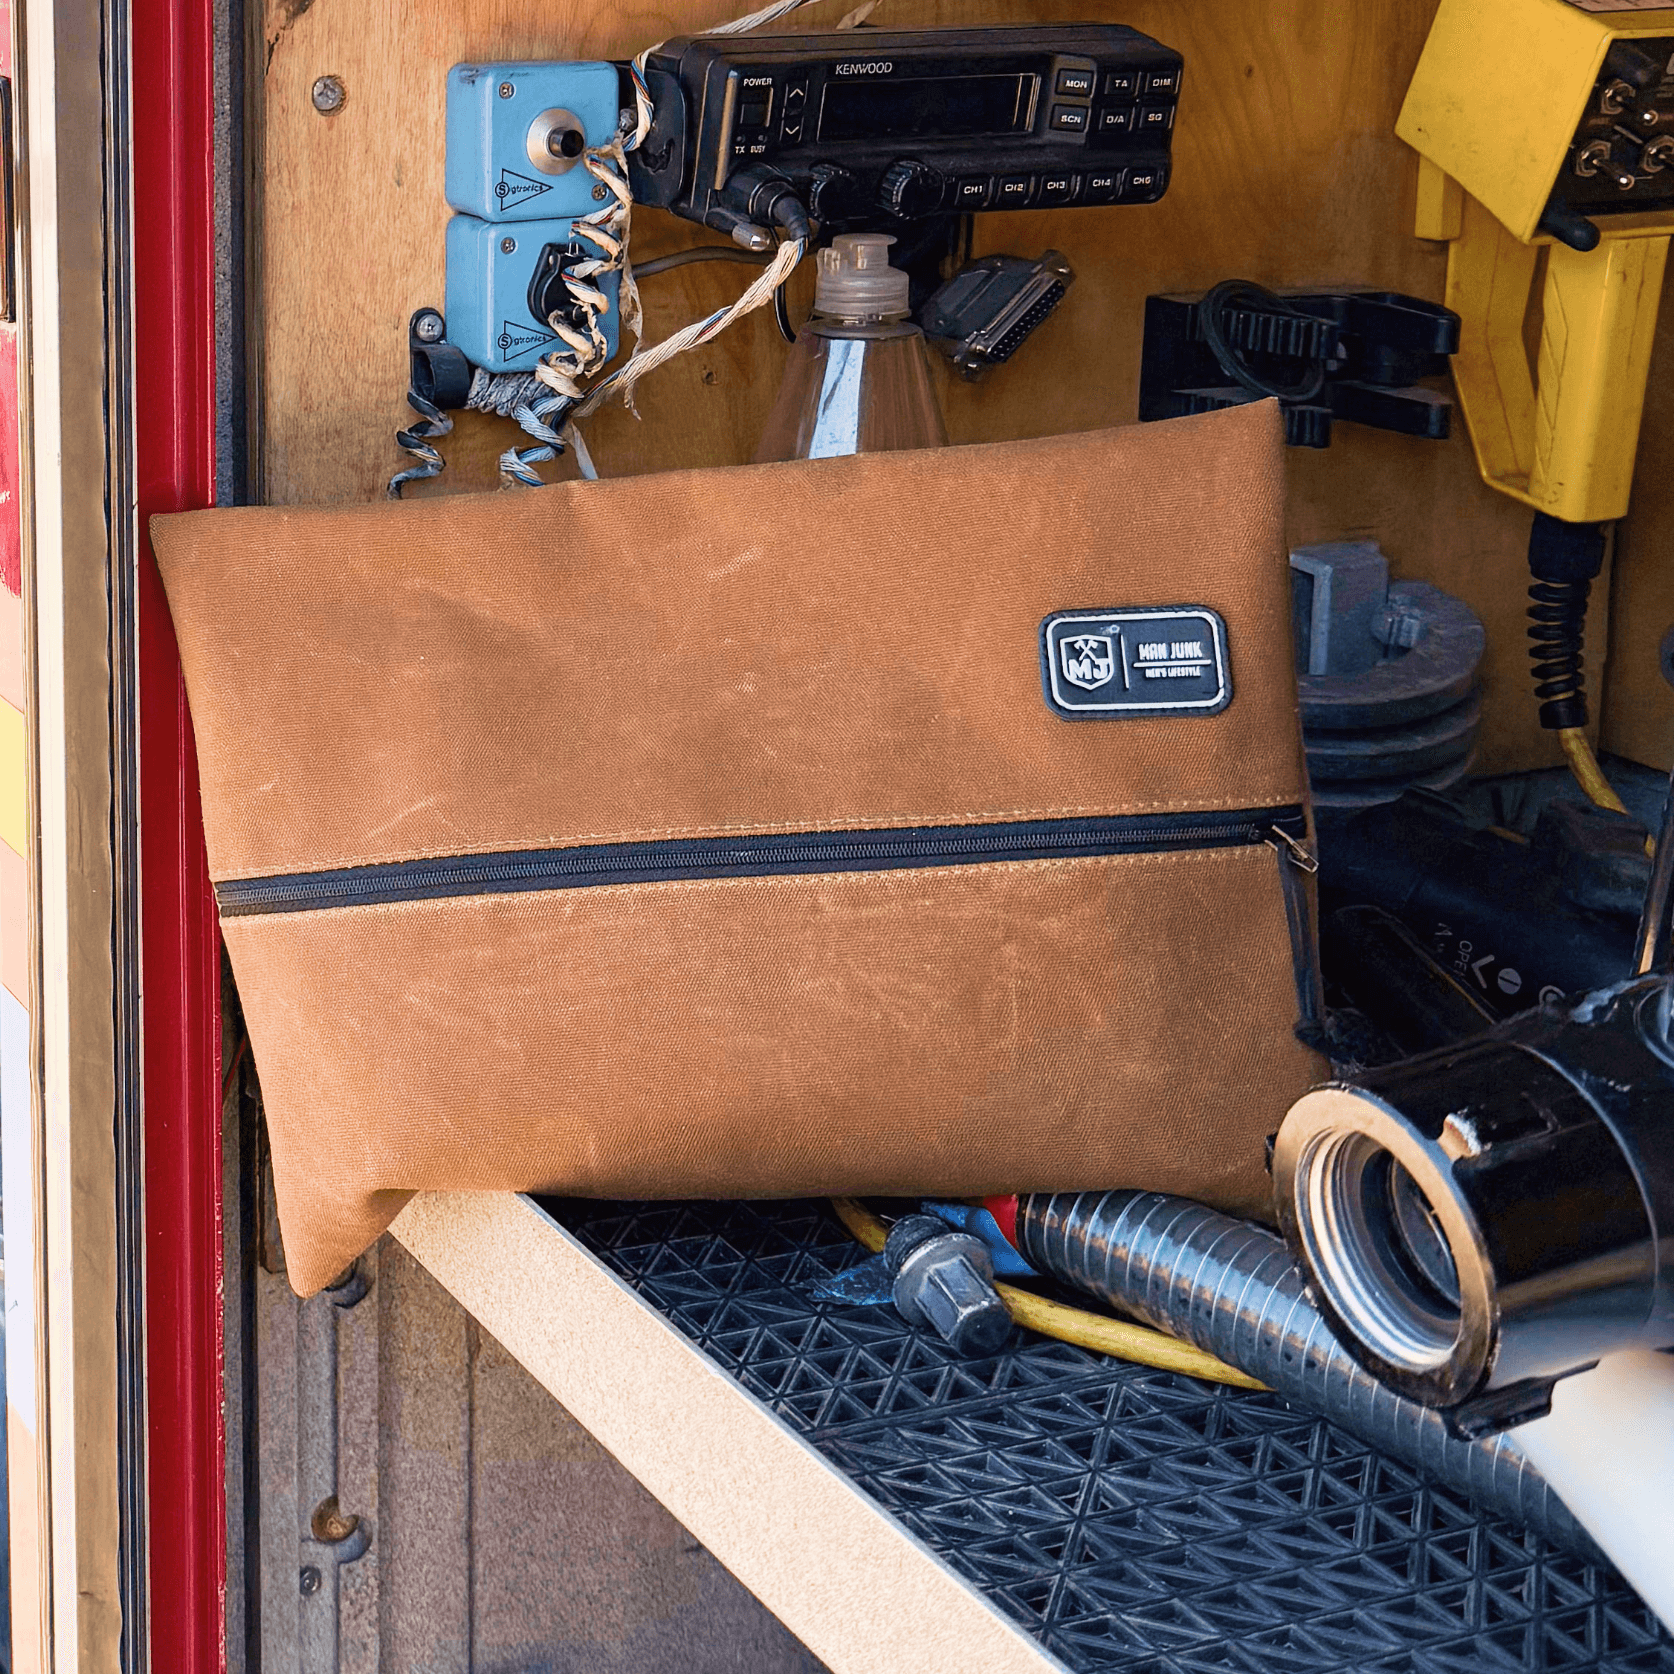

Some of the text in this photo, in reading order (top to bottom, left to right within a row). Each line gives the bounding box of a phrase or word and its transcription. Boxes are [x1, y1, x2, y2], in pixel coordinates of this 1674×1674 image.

[835, 62, 893, 75] KENWOOD
[743, 77, 773, 87] POWER
[1065, 79, 1087, 89] MON
[1115, 79, 1128, 88] TA
[1152, 77, 1172, 87] DIM
[1060, 114, 1081, 124] SCN
[1106, 114, 1124, 124] D/A
[734, 145, 745, 155] TX
[1004, 182, 1024, 192] CH2
[1046, 181, 1066, 190] CH3
[1092, 178, 1111, 188] CH4
[963, 185, 983, 195] CH1
[1138, 641, 1203, 660] MAN JUNK
